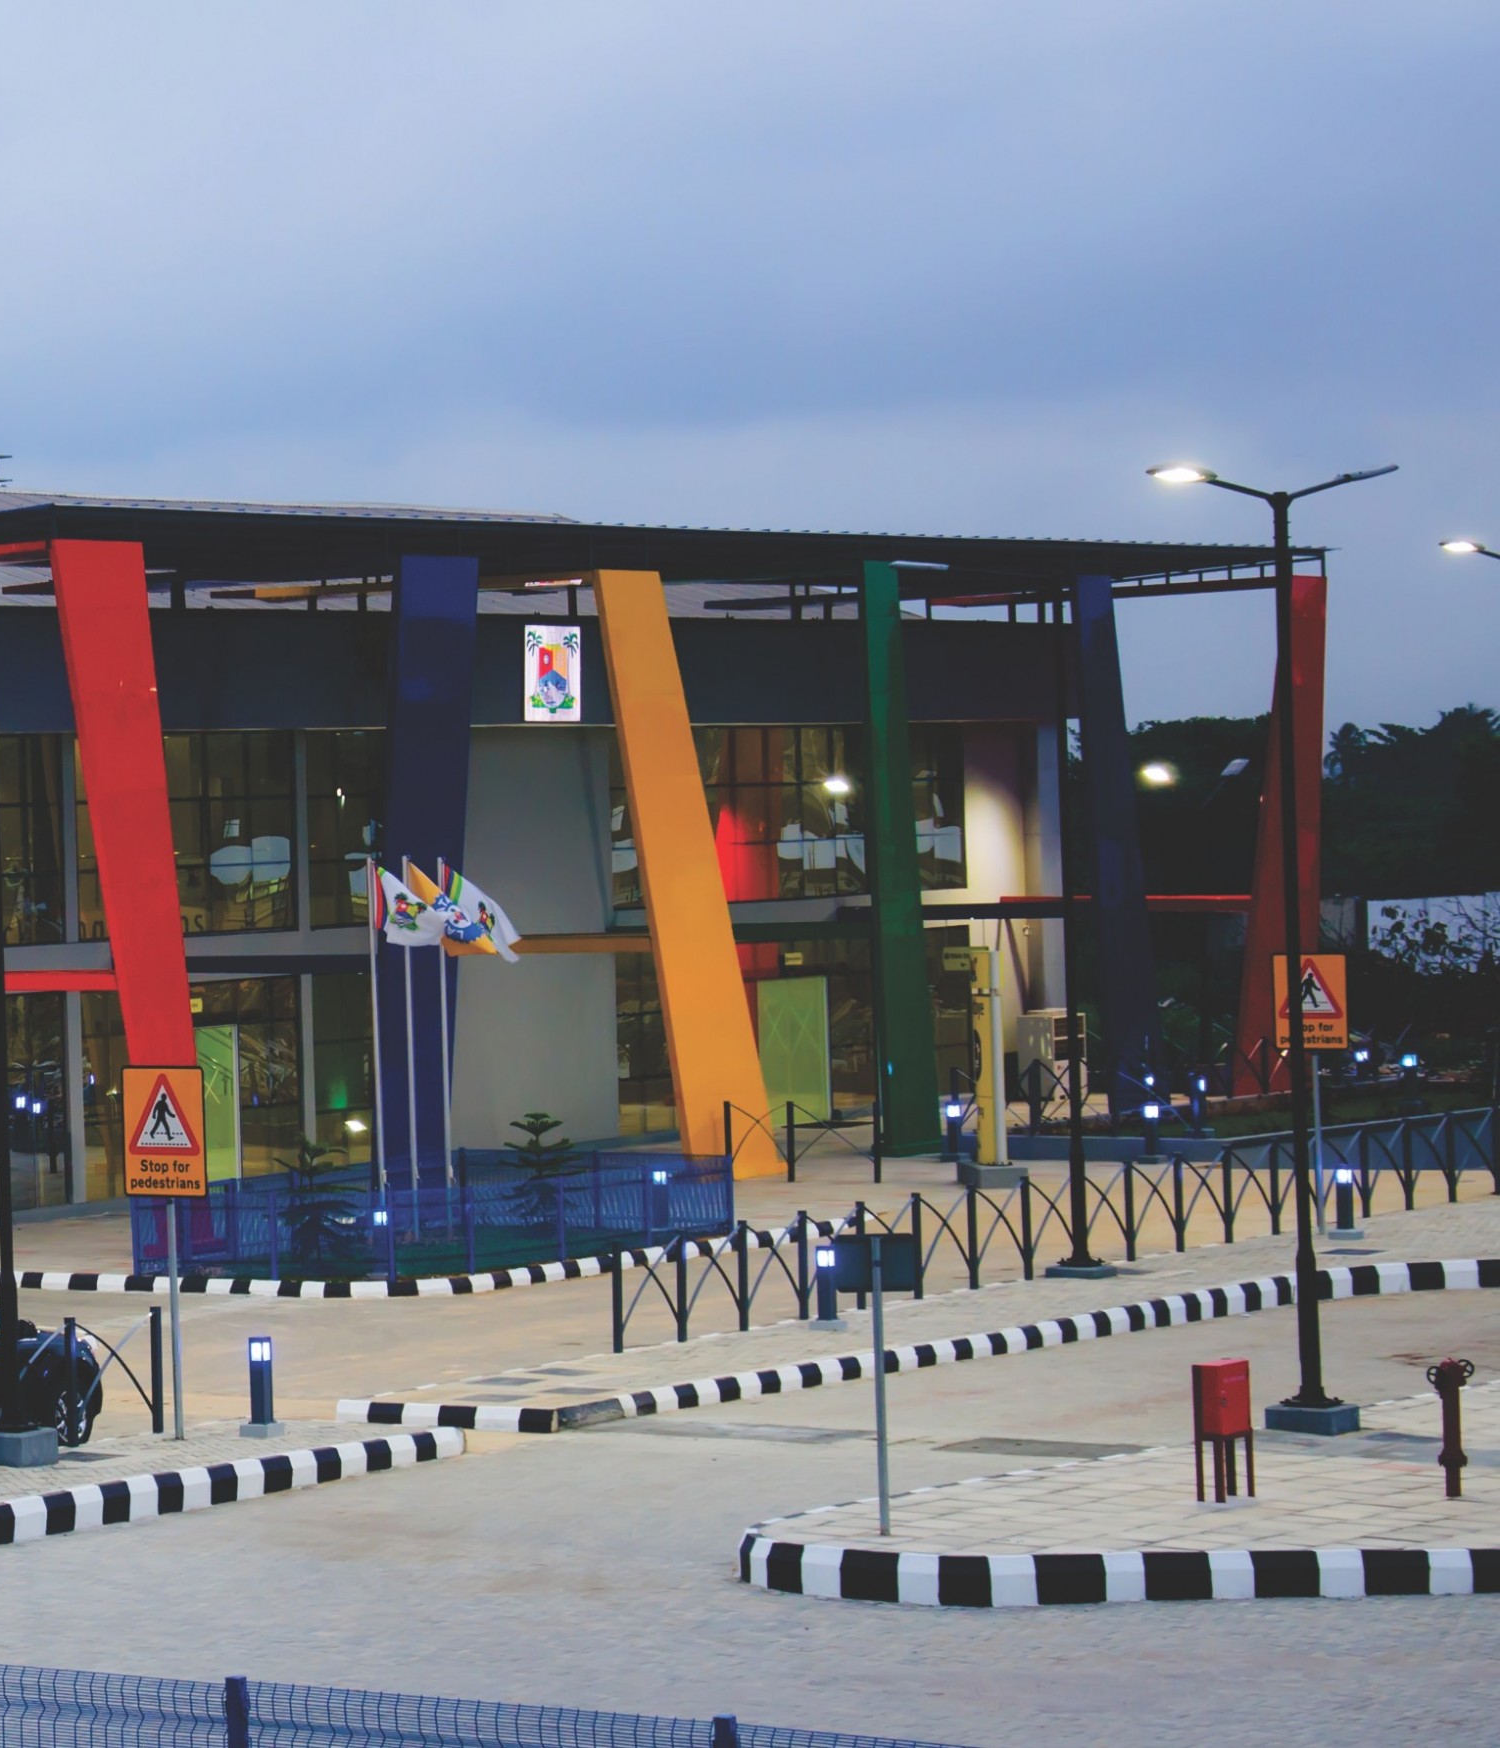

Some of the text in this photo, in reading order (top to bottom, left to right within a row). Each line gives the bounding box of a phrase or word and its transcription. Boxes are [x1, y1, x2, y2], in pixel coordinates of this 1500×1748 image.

[1318, 1022, 1334, 1032] for
[1280, 1034, 1343, 1045] pstrians
[140, 1159, 190, 1174] Stop for
[130, 1176, 201, 1190] pedestrians
